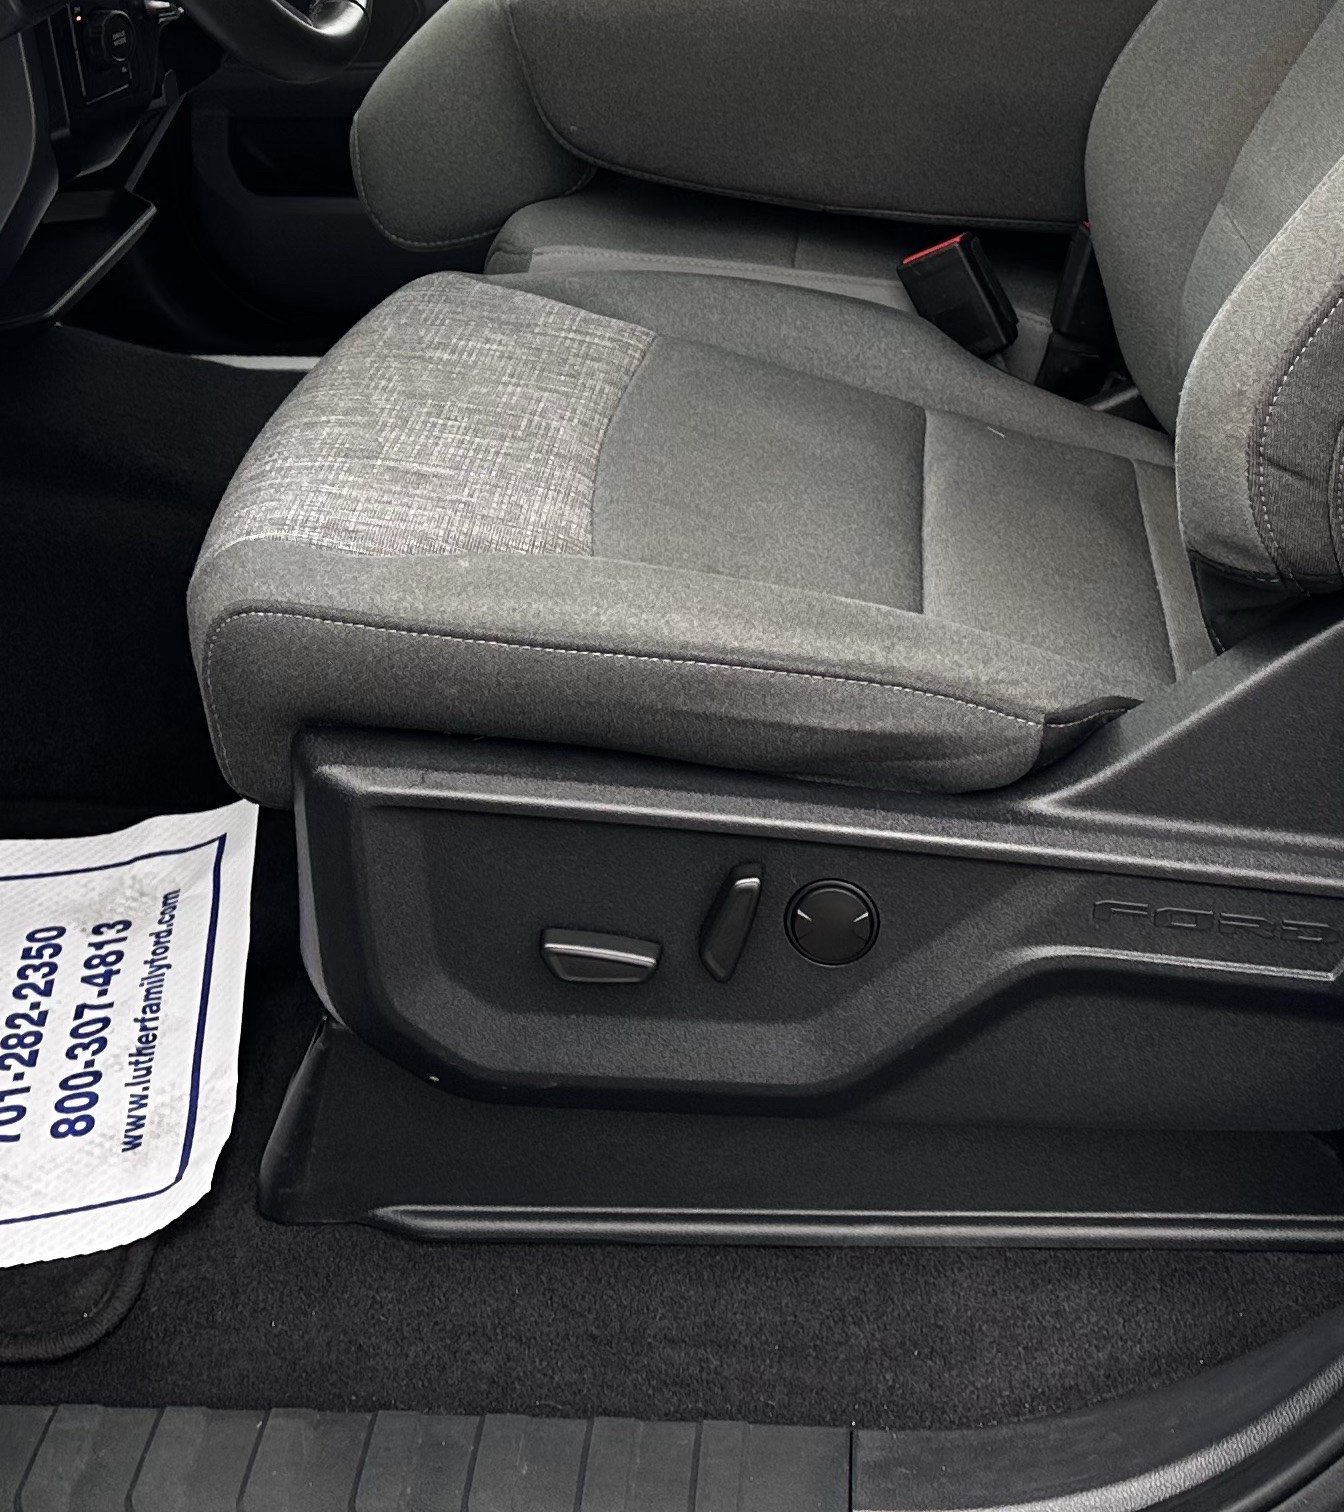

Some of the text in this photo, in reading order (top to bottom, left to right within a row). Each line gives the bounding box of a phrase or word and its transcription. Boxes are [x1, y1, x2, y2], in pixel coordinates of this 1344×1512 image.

[50, 919, 133, 1139] 800-307-4813
[121, 889, 181, 1153] www.lutherfamilyford.com
[1092, 900, 1340, 944] FORD
